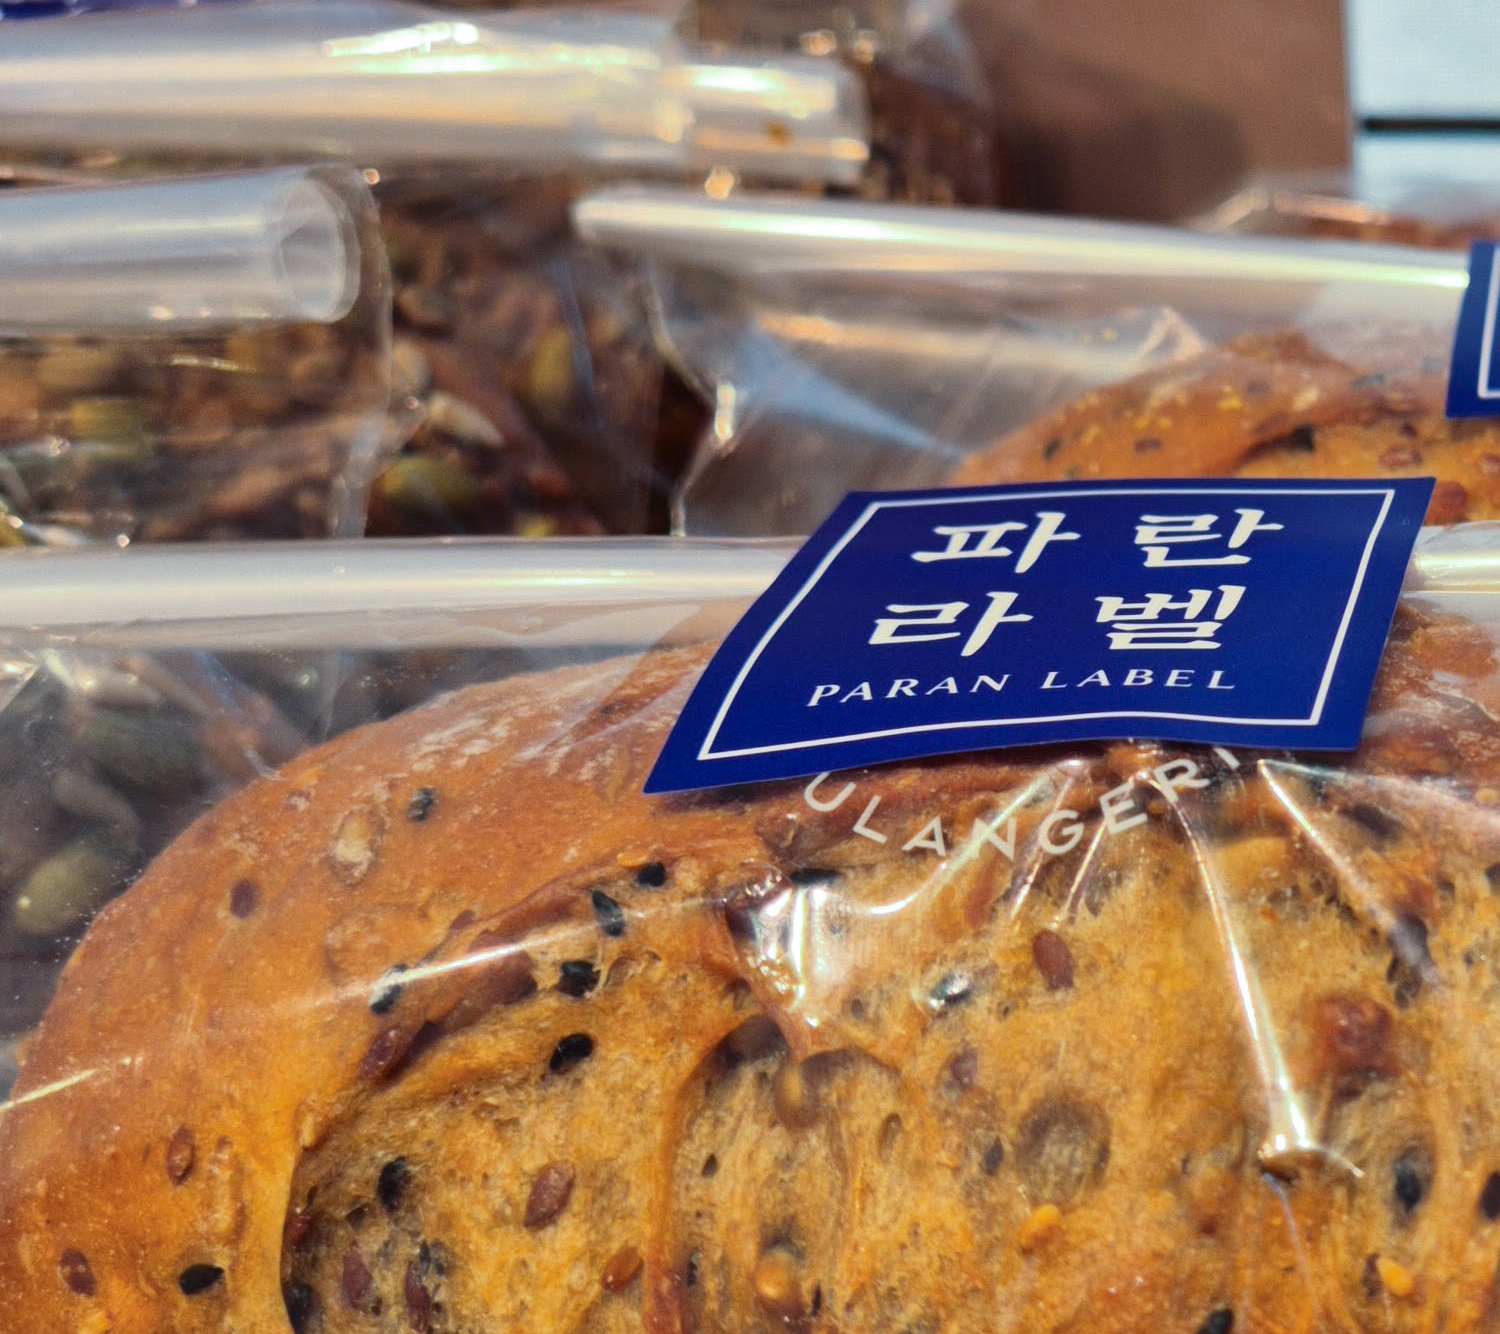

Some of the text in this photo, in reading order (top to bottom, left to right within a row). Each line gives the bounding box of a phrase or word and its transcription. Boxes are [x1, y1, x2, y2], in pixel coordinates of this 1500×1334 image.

[911, 507, 1284, 574] 파란
[867, 584, 1247, 657] 라벨
[807, 668, 1237, 708] PARAN LABEL
